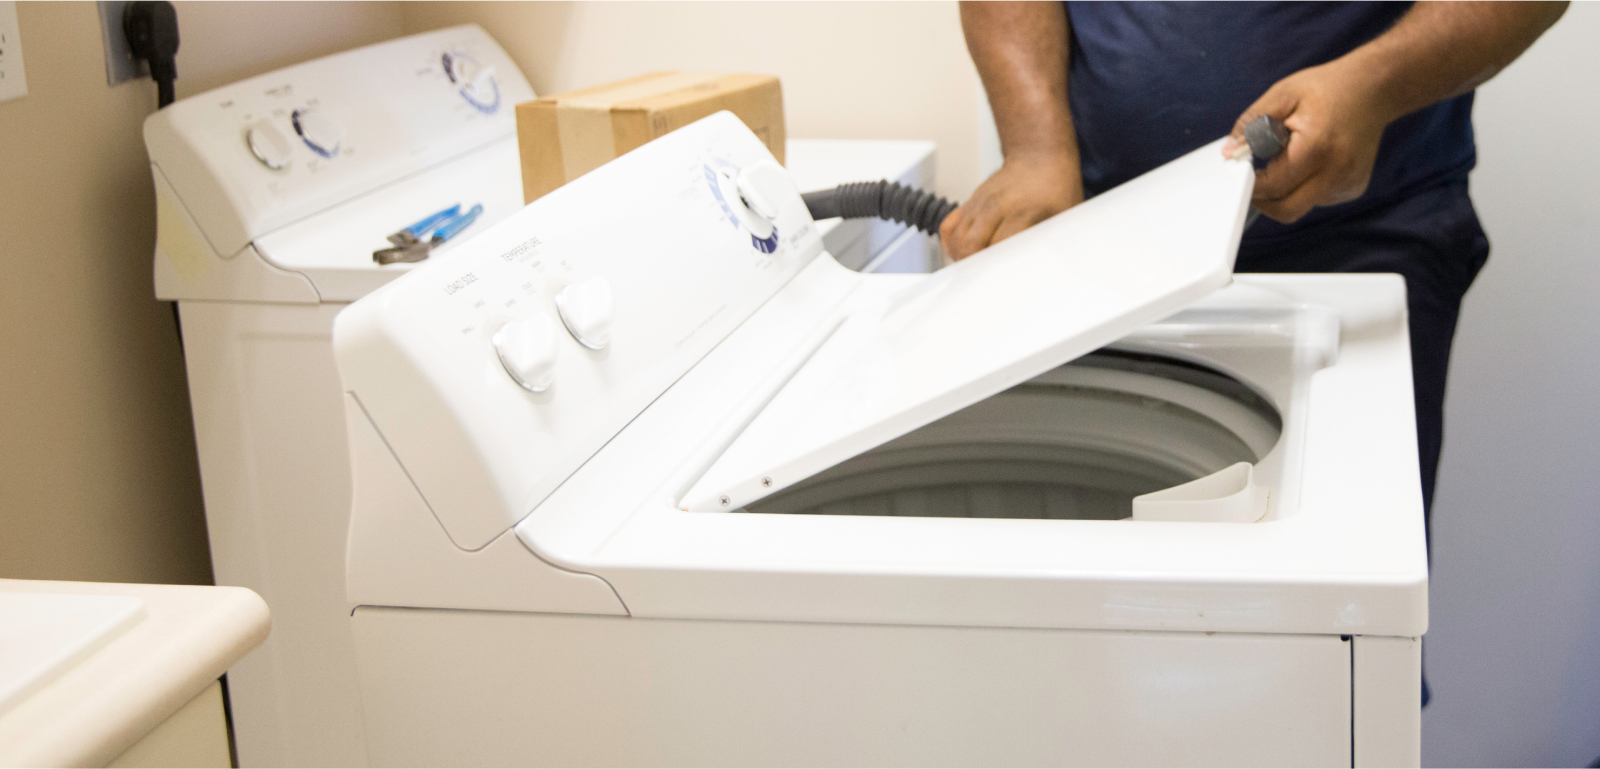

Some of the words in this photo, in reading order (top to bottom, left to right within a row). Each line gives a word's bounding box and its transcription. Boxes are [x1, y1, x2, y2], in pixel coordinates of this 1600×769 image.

[500, 236, 542, 262] TEMPERATURE
[443, 280, 465, 295] LOAD
[461, 272, 479, 286] SIZE
